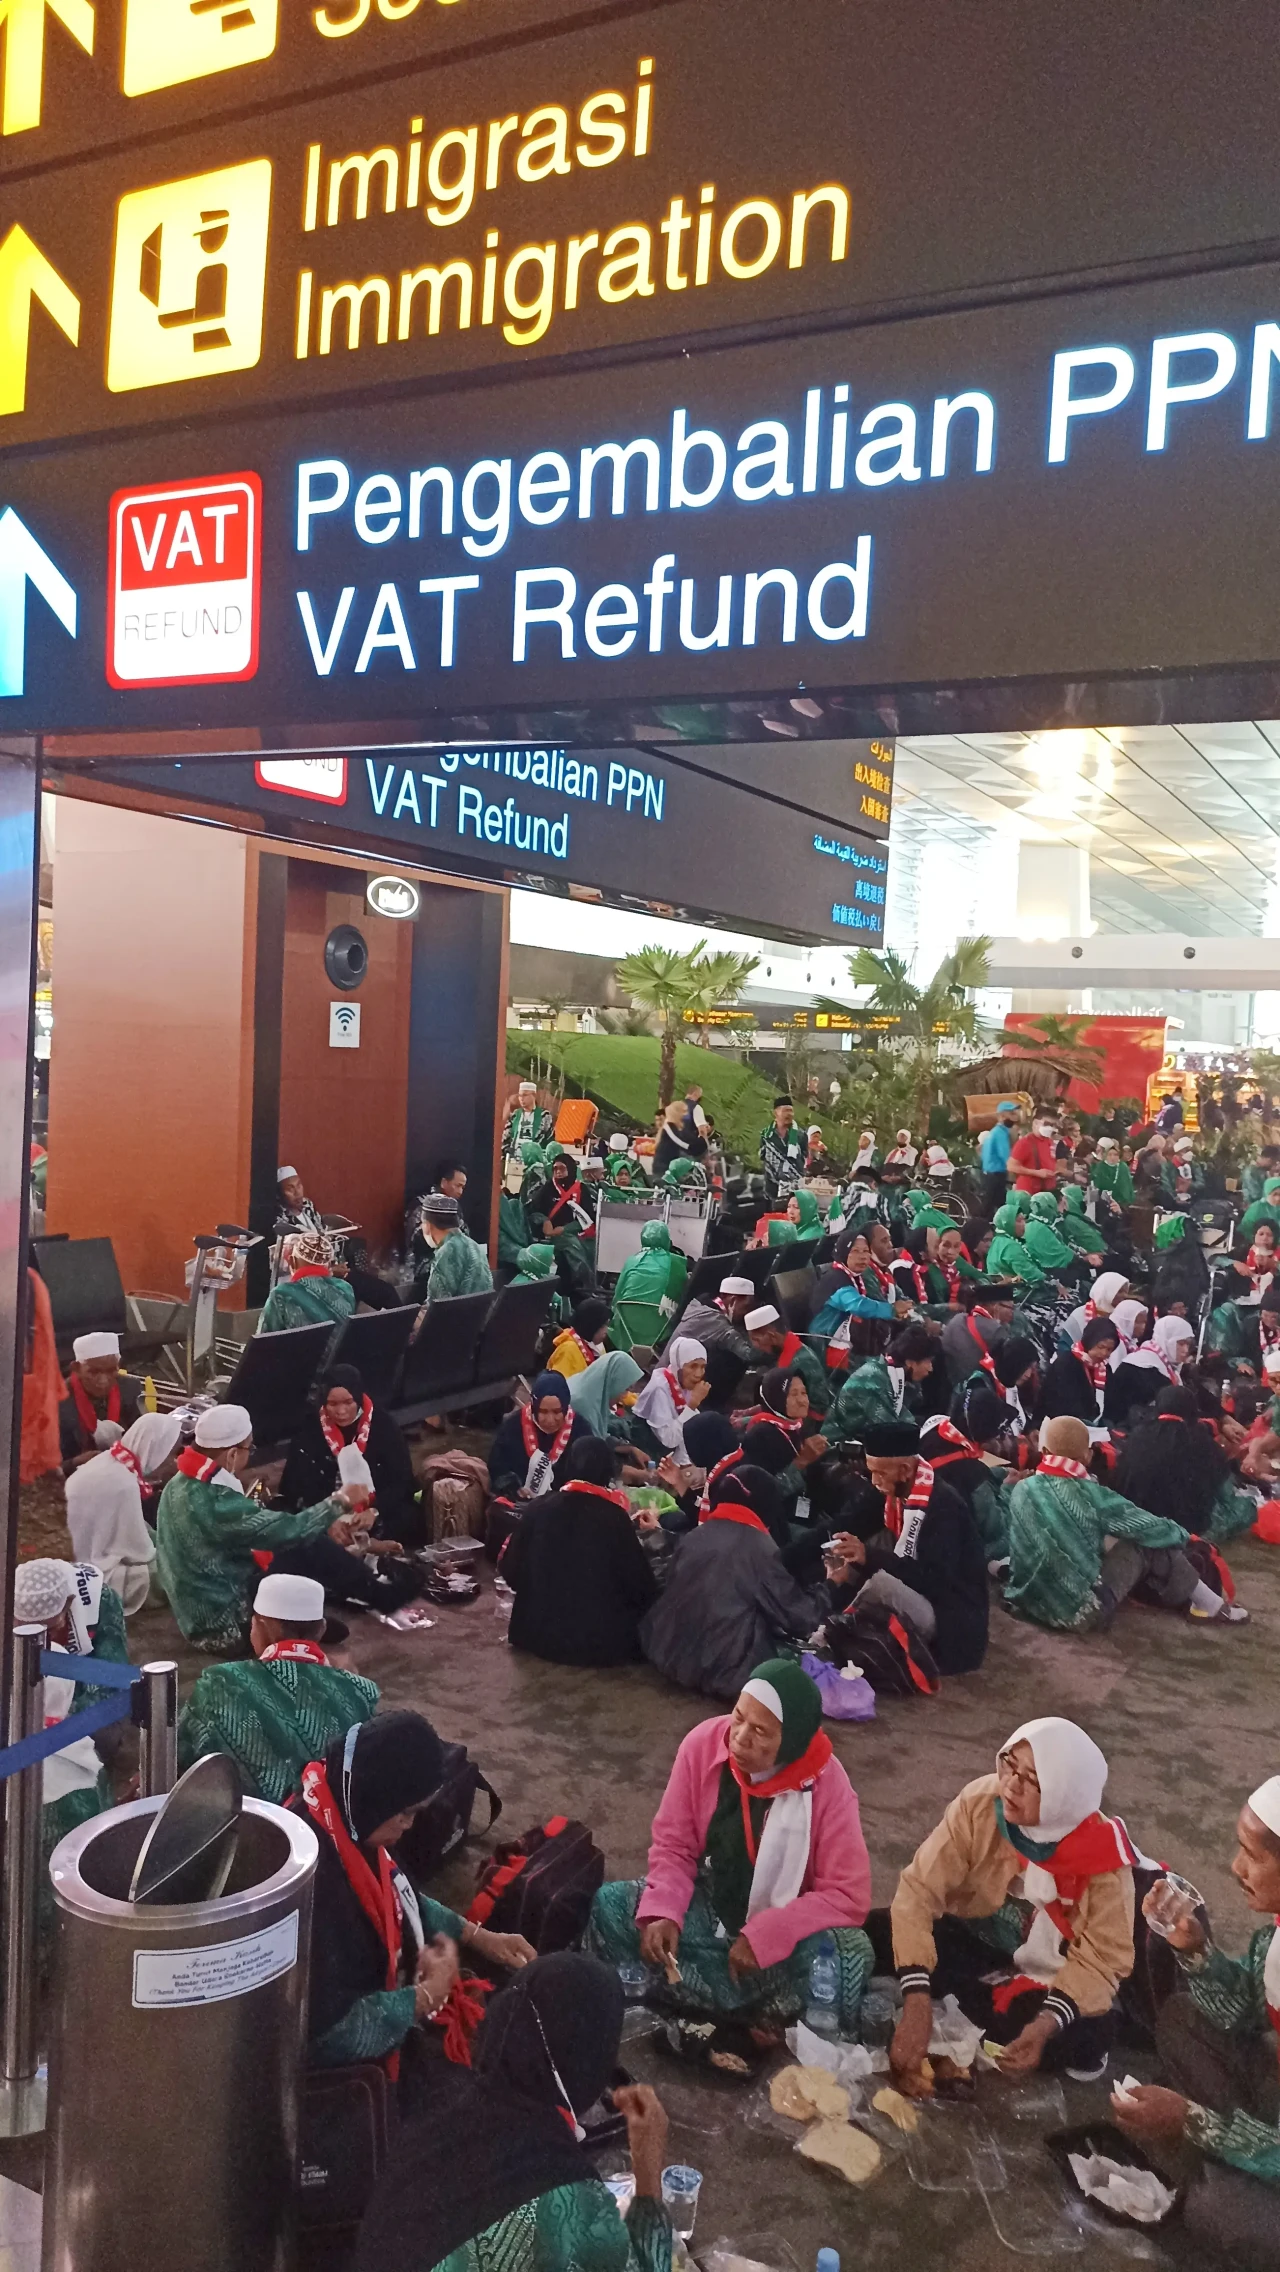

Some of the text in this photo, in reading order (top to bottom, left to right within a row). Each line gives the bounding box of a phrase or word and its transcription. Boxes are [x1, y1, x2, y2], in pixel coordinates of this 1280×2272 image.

[303, 57, 655, 231] Imigrasi
[296, 182, 850, 359] Immigration
[296, 384, 995, 558] Pengembalian
[131, 504, 239, 572] VAT
[124, 605, 242, 641] REFUND
[296, 535, 871, 676] VAT Refund
[366, 758, 568, 858] VAT Refund
[607, 762, 664, 821] PPN
[76, 1570, 92, 1606] TOUR
